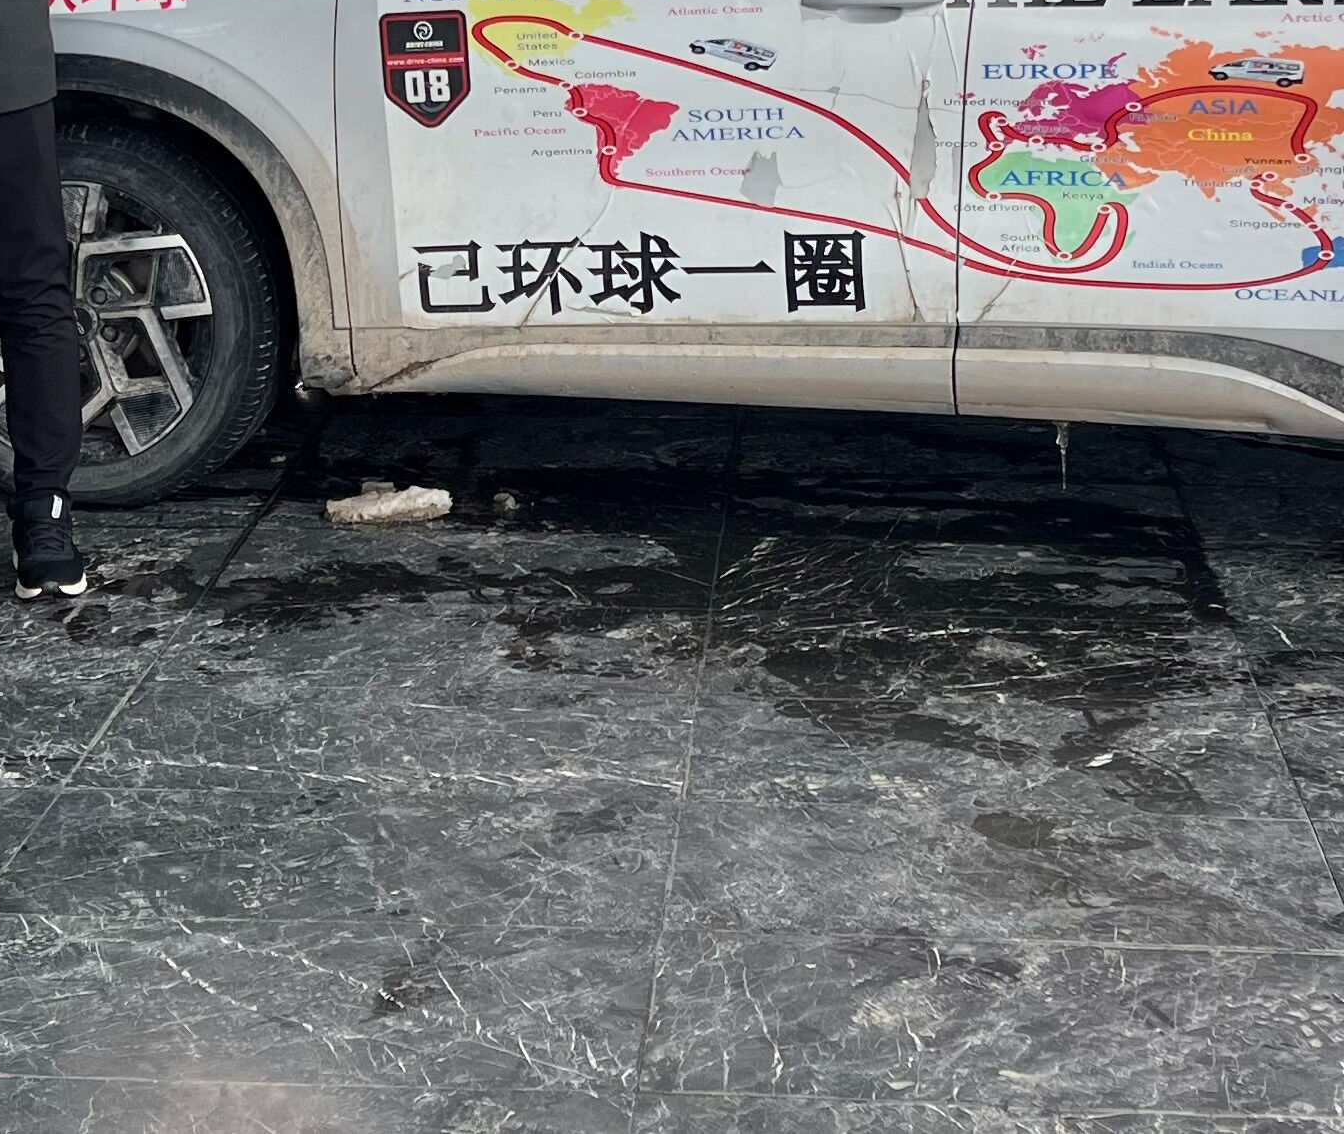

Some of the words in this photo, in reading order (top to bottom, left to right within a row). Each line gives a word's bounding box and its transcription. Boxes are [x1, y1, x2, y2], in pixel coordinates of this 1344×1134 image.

[668, 6, 717, 17] Atlantic
[723, 5, 764, 15] Ocean
[1281, 13, 1334, 23] Arctic
[516, 30, 558, 41] United
[516, 41, 558, 51] States
[528, 57, 575, 67] Mexico
[574, 68, 637, 79] Colombia
[982, 63, 1119, 79] EUROPE
[404, 69, 452, 104] 08
[1188, 99, 1259, 115] ASIA
[532, 109, 562, 118] Peru
[687, 108, 785, 124] SOUTH
[474, 127, 520, 137] Pacific
[524, 126, 566, 136] Ocean
[671, 126, 805, 142] AMERICA
[1187, 129, 1253, 142] China
[934, 140, 978, 149] orocco
[531, 146, 593, 158] Argentina
[1244, 157, 1292, 165] Yunnan
[645, 167, 706, 178] Southern
[1000, 170, 1129, 187] AFRICA
[1183, 179, 1243, 188] Thailand
[1062, 191, 1105, 202] Kenya
[989, 203, 1037, 212] d'Ivoire
[1229, 218, 1302, 230] Singapore
[1000, 233, 1040, 242] South
[1000, 244, 1040, 253] Africa
[1132, 258, 1176, 270] Indian
[1179, 259, 1224, 270] Ocean
